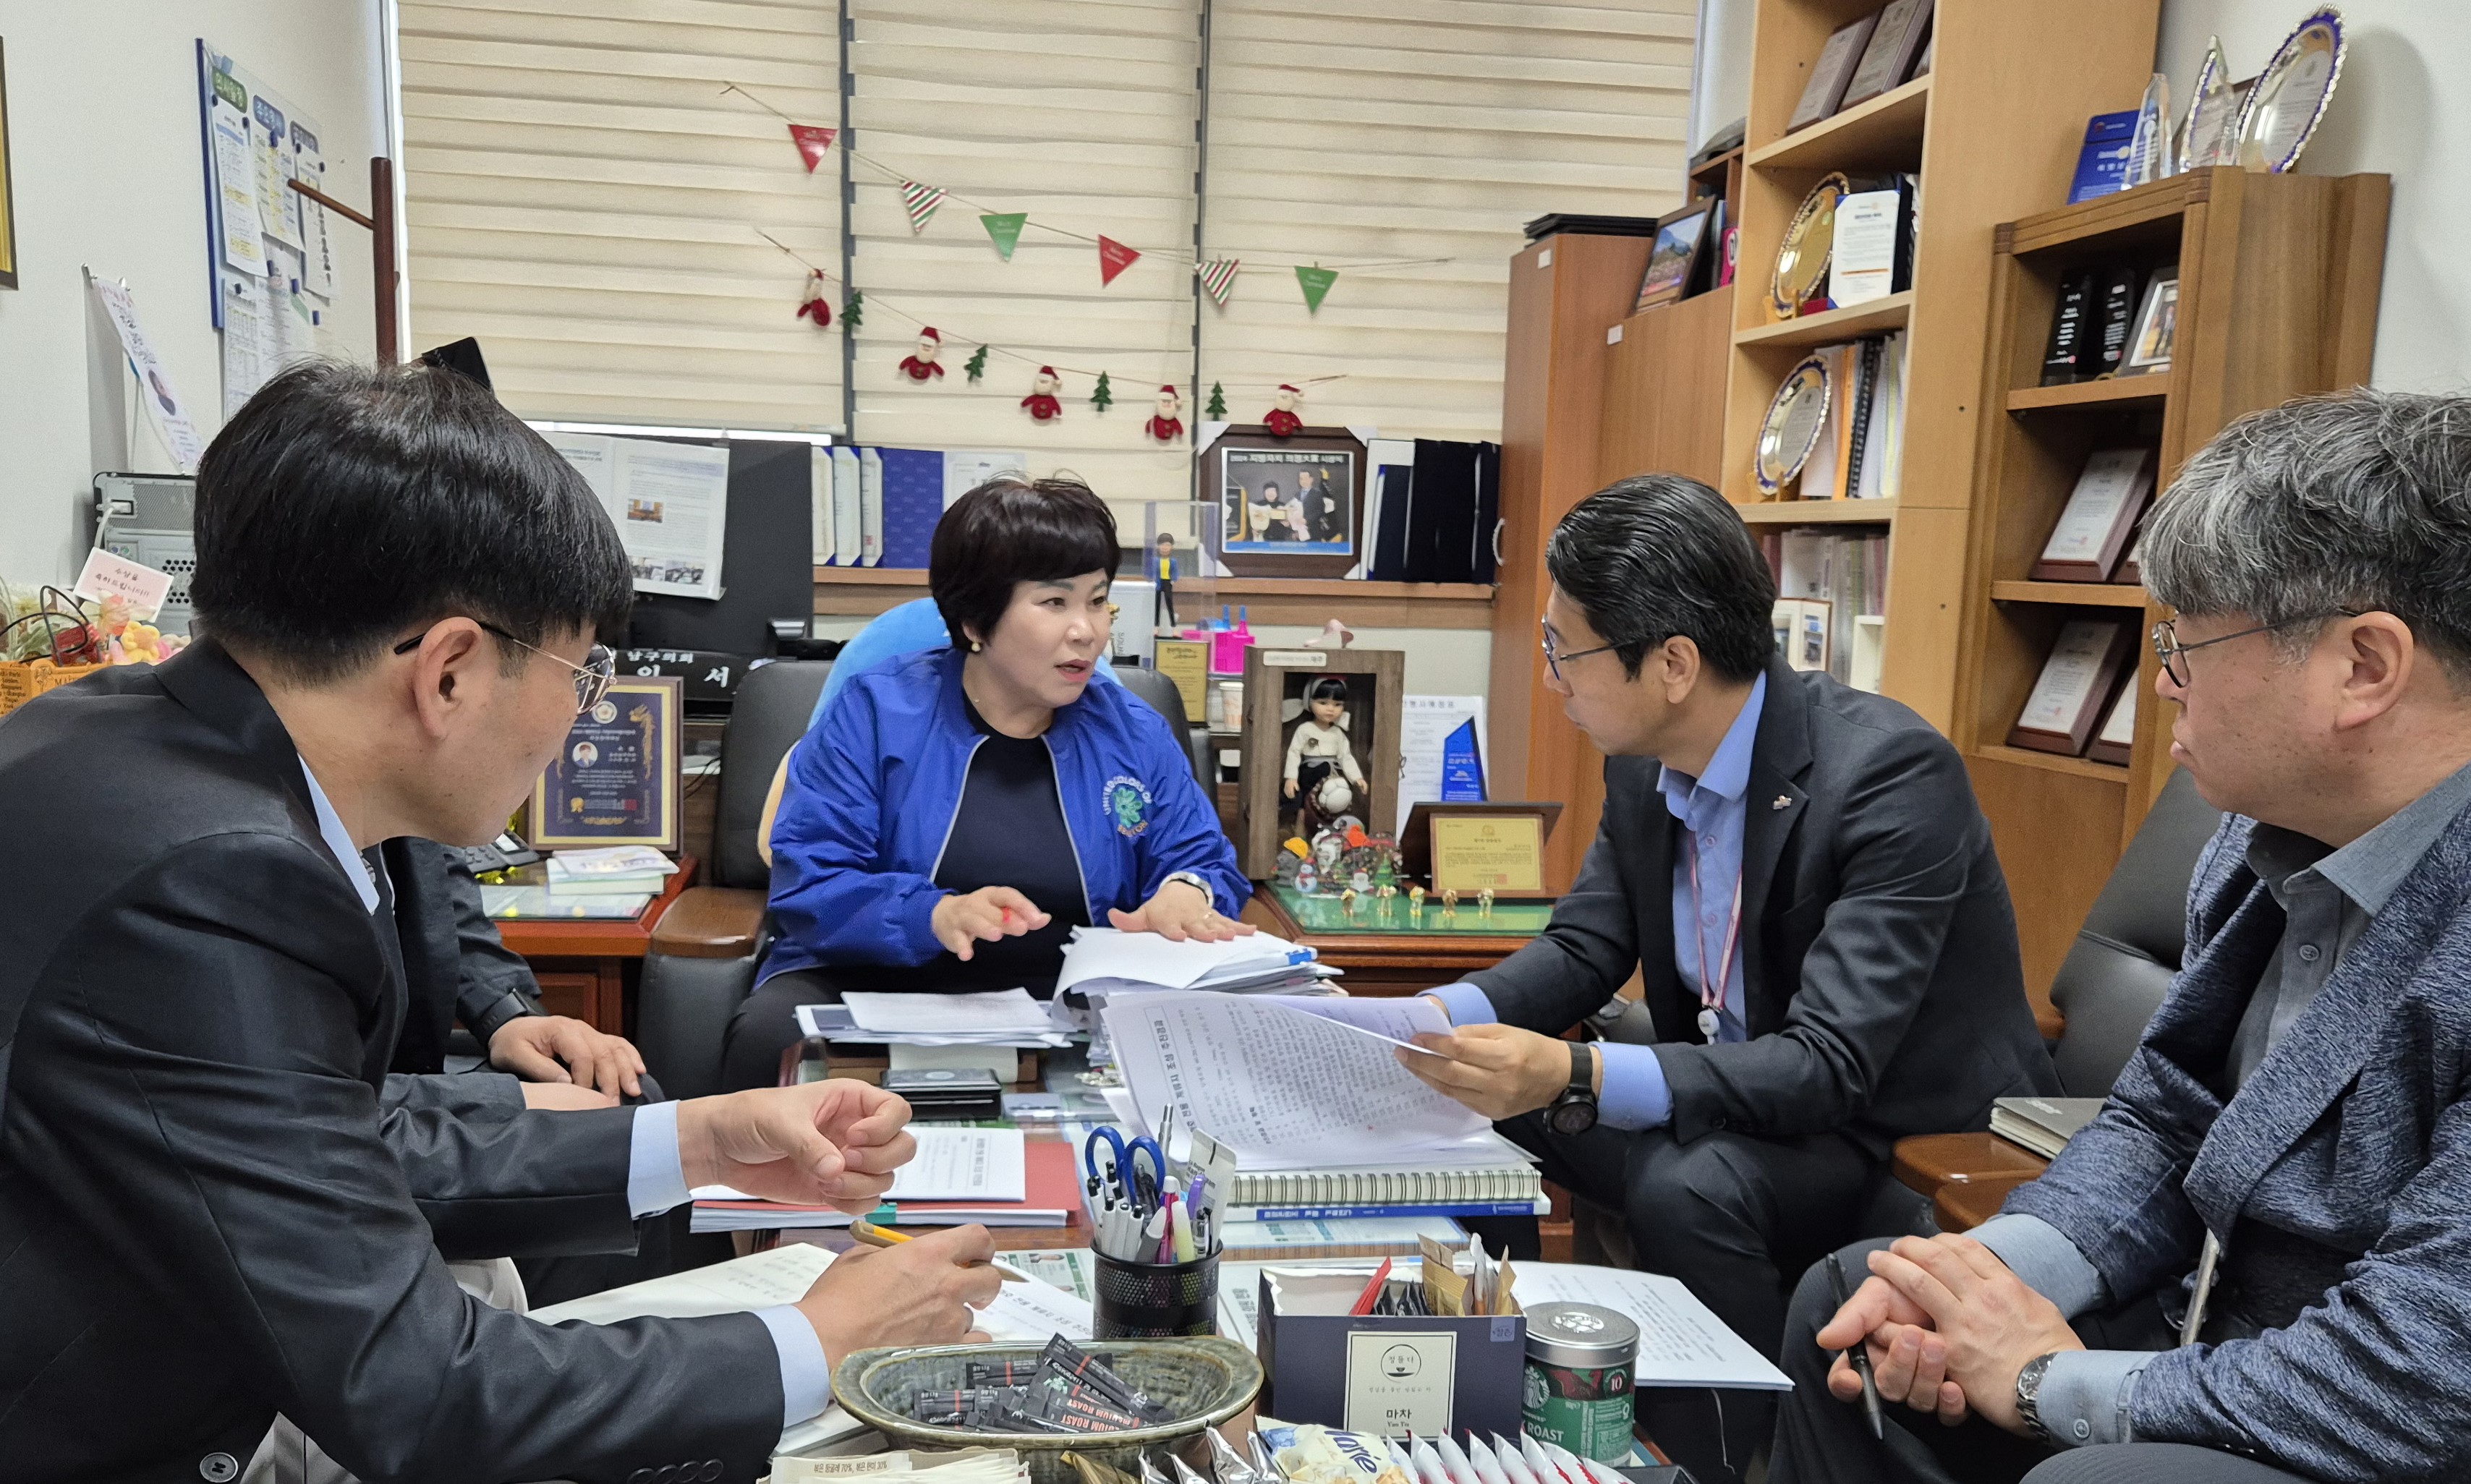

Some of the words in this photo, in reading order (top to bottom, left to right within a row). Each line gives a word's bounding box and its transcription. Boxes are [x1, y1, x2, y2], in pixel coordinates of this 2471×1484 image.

[626, 650, 694, 664] 남구의회
[704, 666, 729, 688] 서
[1141, 790, 1152, 804] OF
[1611, 1376, 1622, 1391] 10
[1067, 1399, 1094, 1414] ROAST
[1060, 1415, 1089, 1428] ROAST
[1386, 1409, 1412, 1420] 마차
[1091, 1423, 1120, 1433] DIUM
[1527, 1422, 1565, 1444] ROAST
